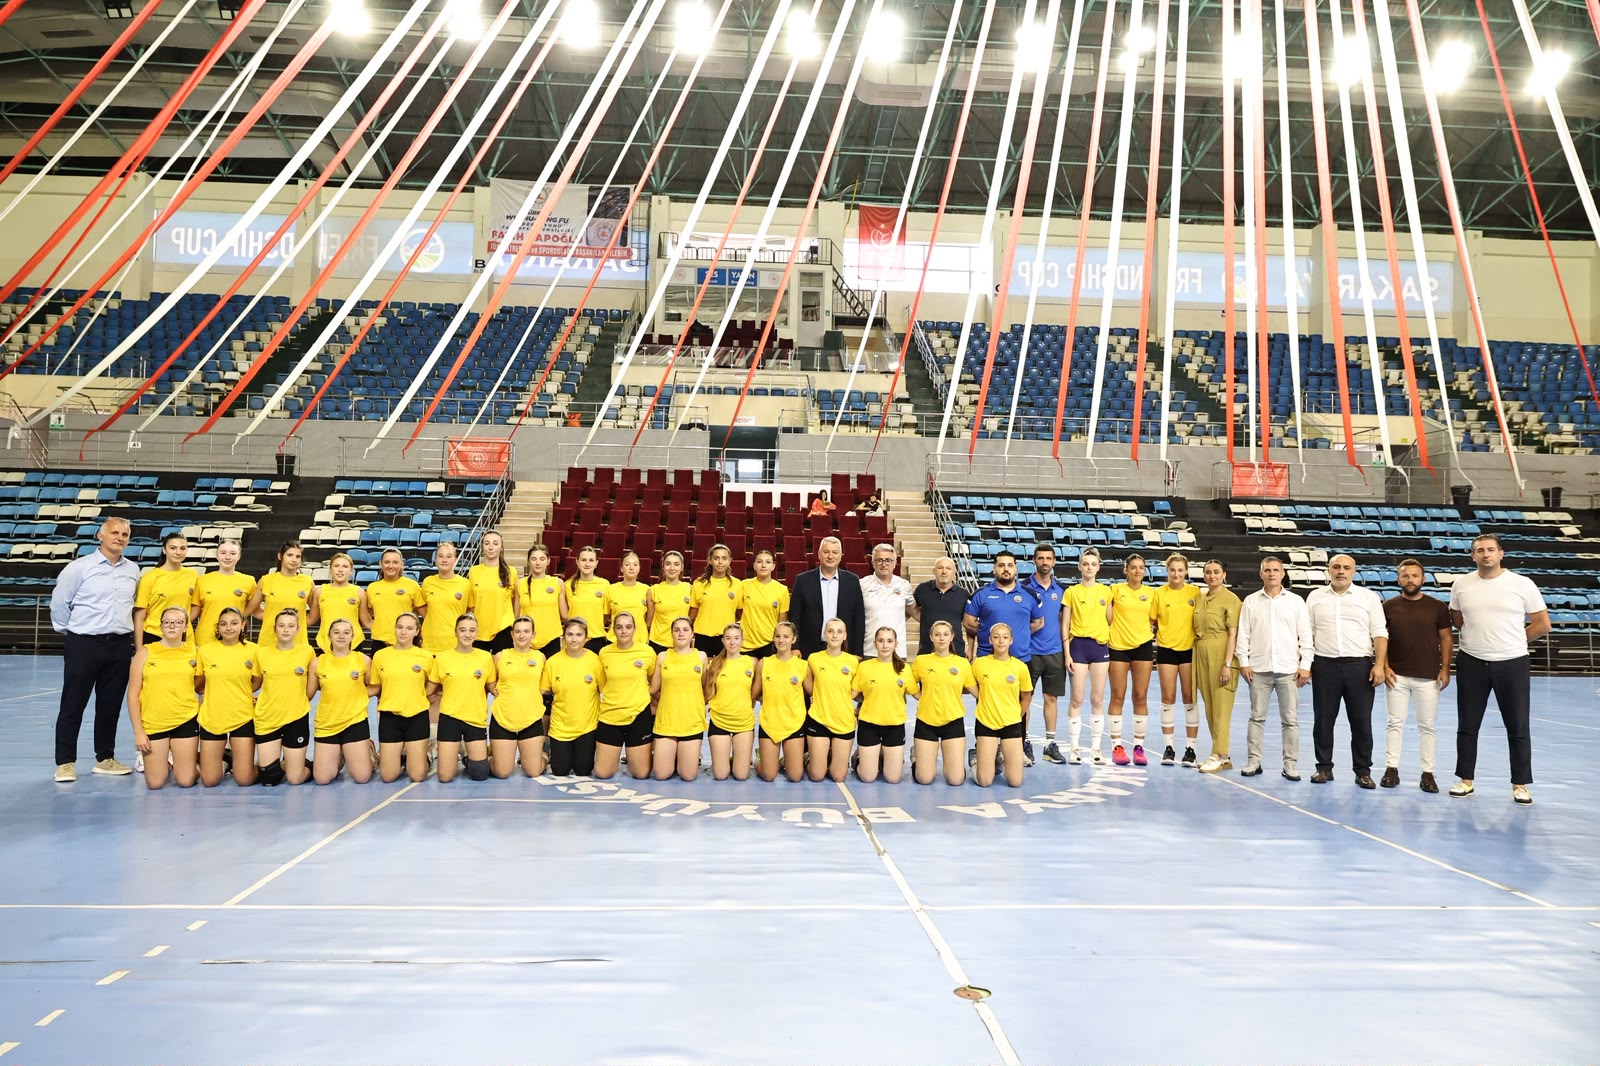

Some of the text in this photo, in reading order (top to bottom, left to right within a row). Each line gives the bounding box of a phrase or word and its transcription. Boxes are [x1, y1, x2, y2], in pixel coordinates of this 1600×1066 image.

[535, 232, 583, 244] APOĞLU
[475, 259, 486, 268] B
[731, 271, 755, 279] YAN
